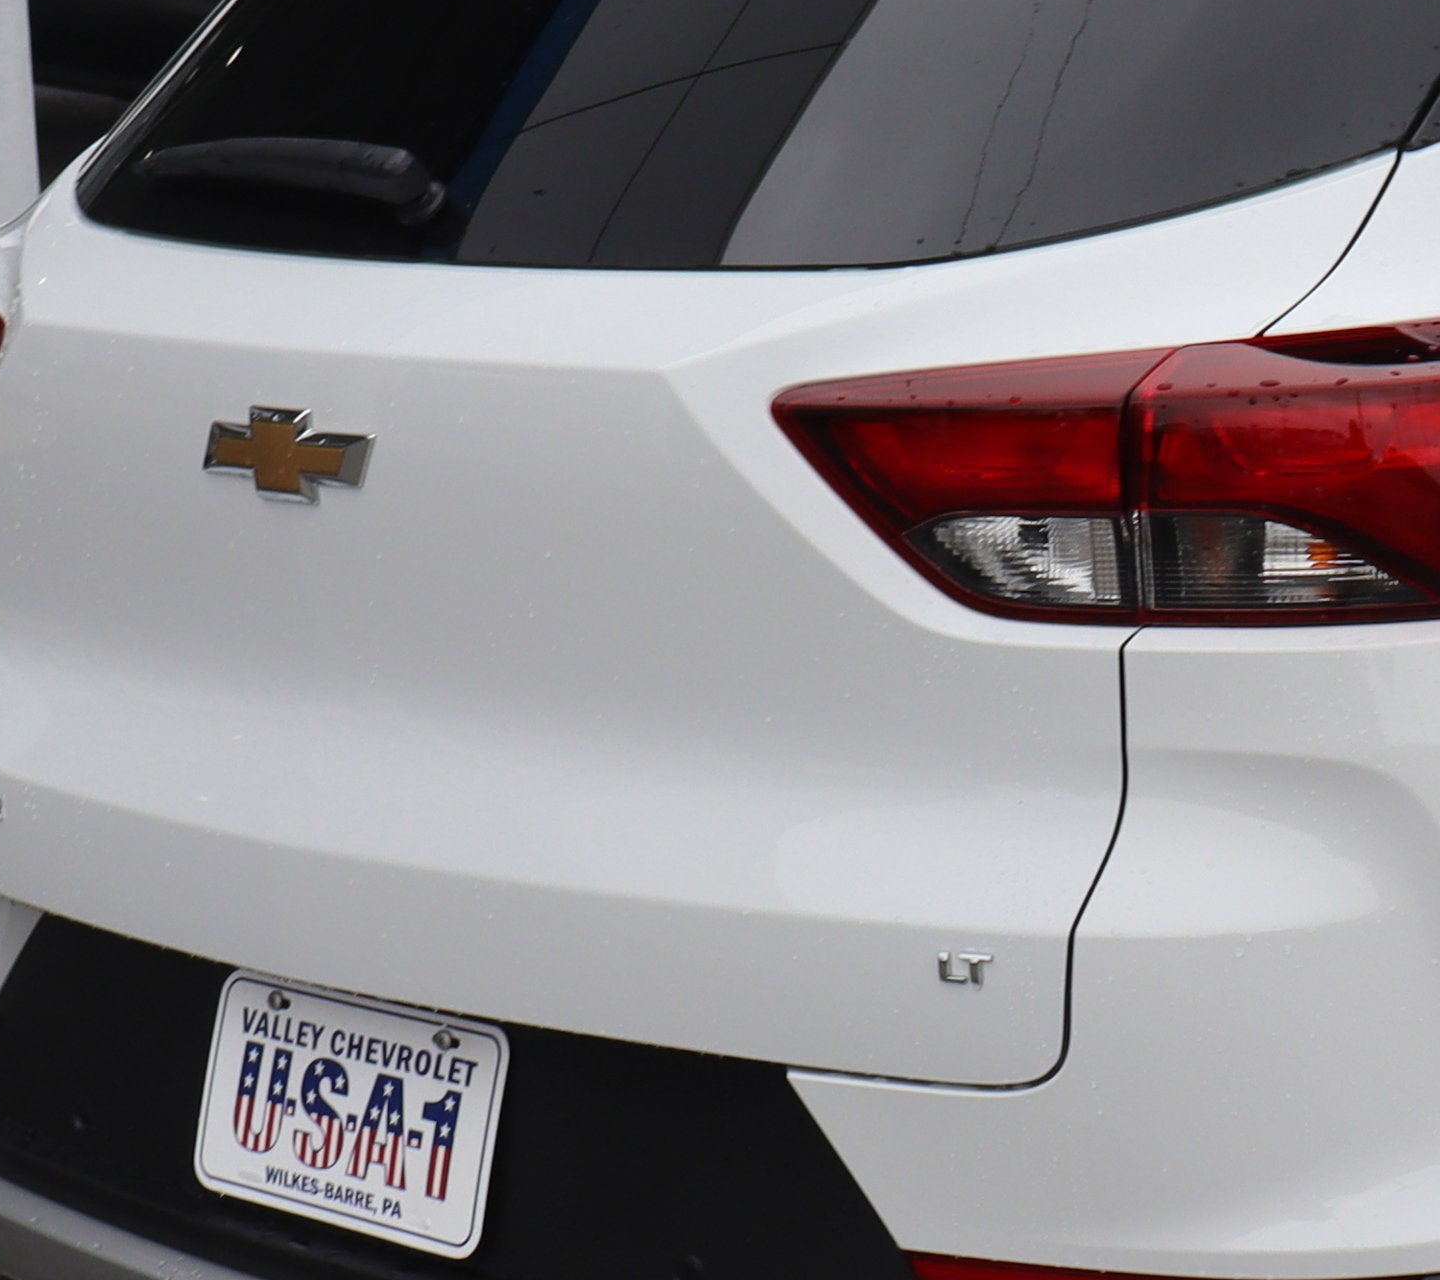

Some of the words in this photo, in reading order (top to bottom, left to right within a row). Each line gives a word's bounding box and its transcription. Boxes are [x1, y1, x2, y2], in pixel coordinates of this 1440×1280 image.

[937, 950, 994, 984] LT
[242, 1007, 325, 1051] VALLEY
[330, 1029, 479, 1088] CHEVROLET
[265, 1164, 377, 1216] WILKES-BARRE,
[381, 1198, 403, 1219] PA
